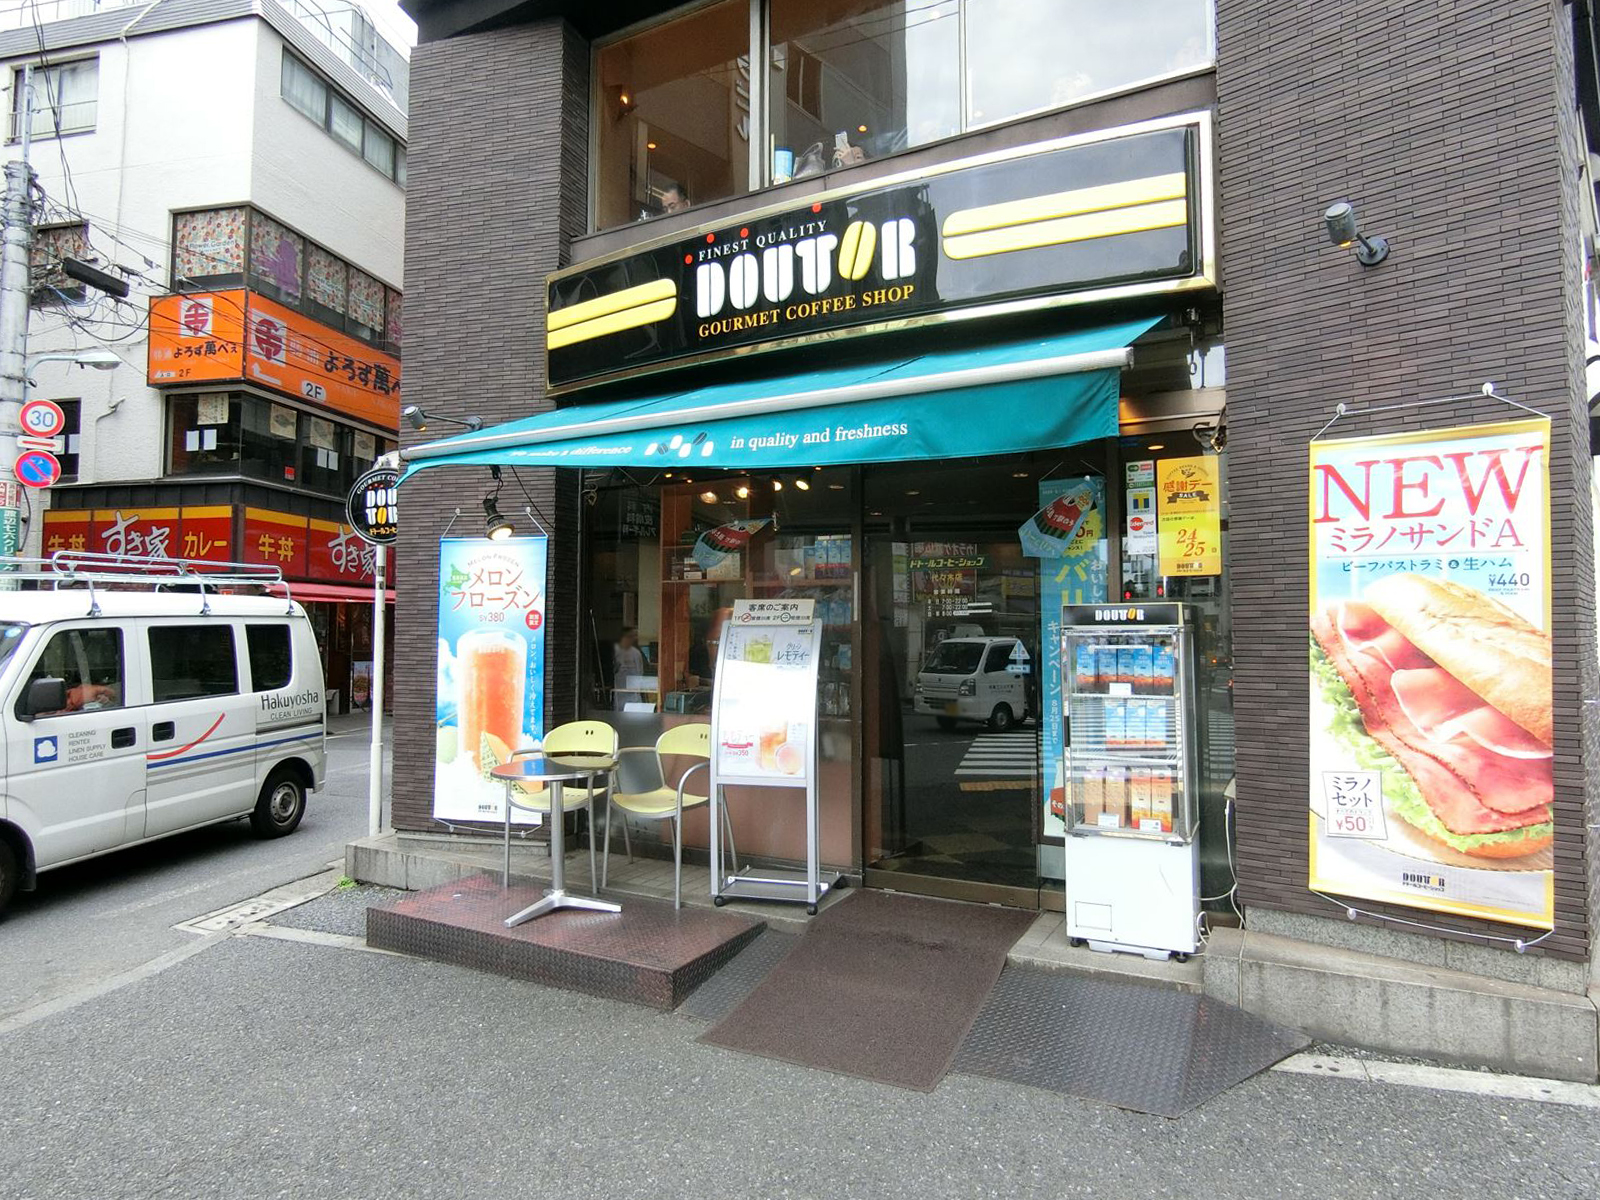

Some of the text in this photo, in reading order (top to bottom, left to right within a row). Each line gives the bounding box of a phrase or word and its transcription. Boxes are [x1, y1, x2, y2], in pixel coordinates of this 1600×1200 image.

[698, 220, 827, 262] FINEST QUALITY
[696, 217, 916, 319] DOUTOR
[698, 284, 915, 338] GOURMET COFFEE SHOP
[179, 368, 191, 377] 2F
[305, 382, 322, 398] 2F
[30, 409, 54, 428] 30
[730, 422, 908, 451] in quality and freshness
[570, 446, 632, 456] difference
[356, 475, 386, 495] GOURMET
[1163, 479, 1213, 493] 感謝デー
[1314, 445, 1543, 524] NEW
[366, 488, 397, 508] DOU
[101, 509, 170, 564] すき家
[184, 531, 228, 558] カレー
[1176, 528, 1197, 544] 24
[1330, 518, 1525, 552] ミラノサンドA
[48, 534, 86, 558] 牛丼
[258, 533, 294, 562] 牛丼
[328, 525, 377, 580] すき家
[1183, 541, 1205, 557] 25
[1463, 557, 1512, 571] 生ハム
[469, 568, 524, 589] メロン
[1489, 572, 1530, 587] ¥440
[451, 585, 540, 610] フローズン
[748, 603, 799, 612] 客席のご案内
[1095, 608, 1144, 621] DOUTOR
[1046, 621, 1061, 695] キャンペーン
[261, 689, 319, 710] Hakuyosha
[271, 707, 313, 721] CLEAN LIVING
[68, 729, 97, 739] CLEANING
[68, 743, 107, 755] LINEN SUPPLY
[68, 751, 104, 763] HOUSE CARE
[1332, 776, 1371, 791] ミラノ
[1332, 792, 1372, 808] セット
[1336, 815, 1366, 832] ¥50
